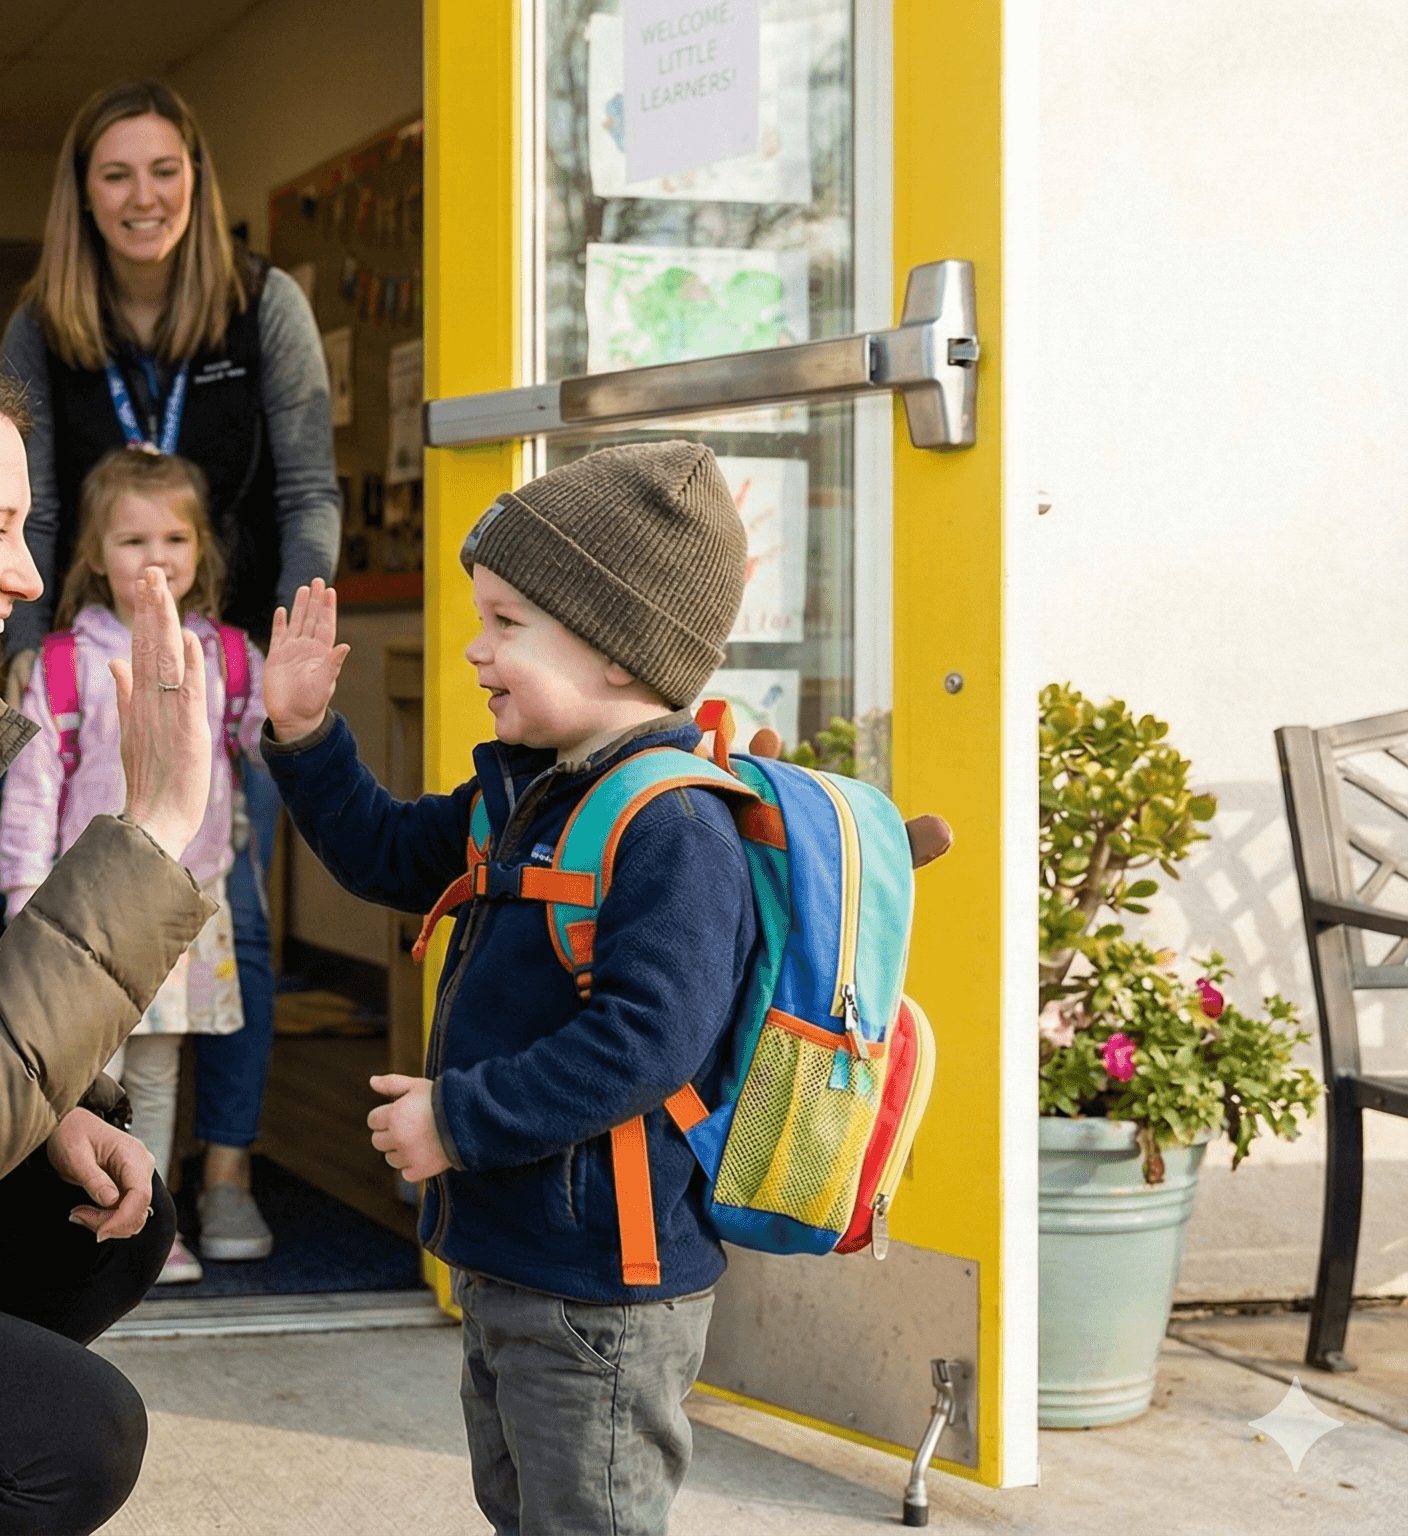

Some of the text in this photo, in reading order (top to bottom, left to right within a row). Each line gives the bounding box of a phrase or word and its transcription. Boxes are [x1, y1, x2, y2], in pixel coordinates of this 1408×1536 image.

[639, 1, 736, 46] WELCOME,
[657, 37, 718, 76] LITTLE
[640, 66, 738, 113] LEARNERS!
